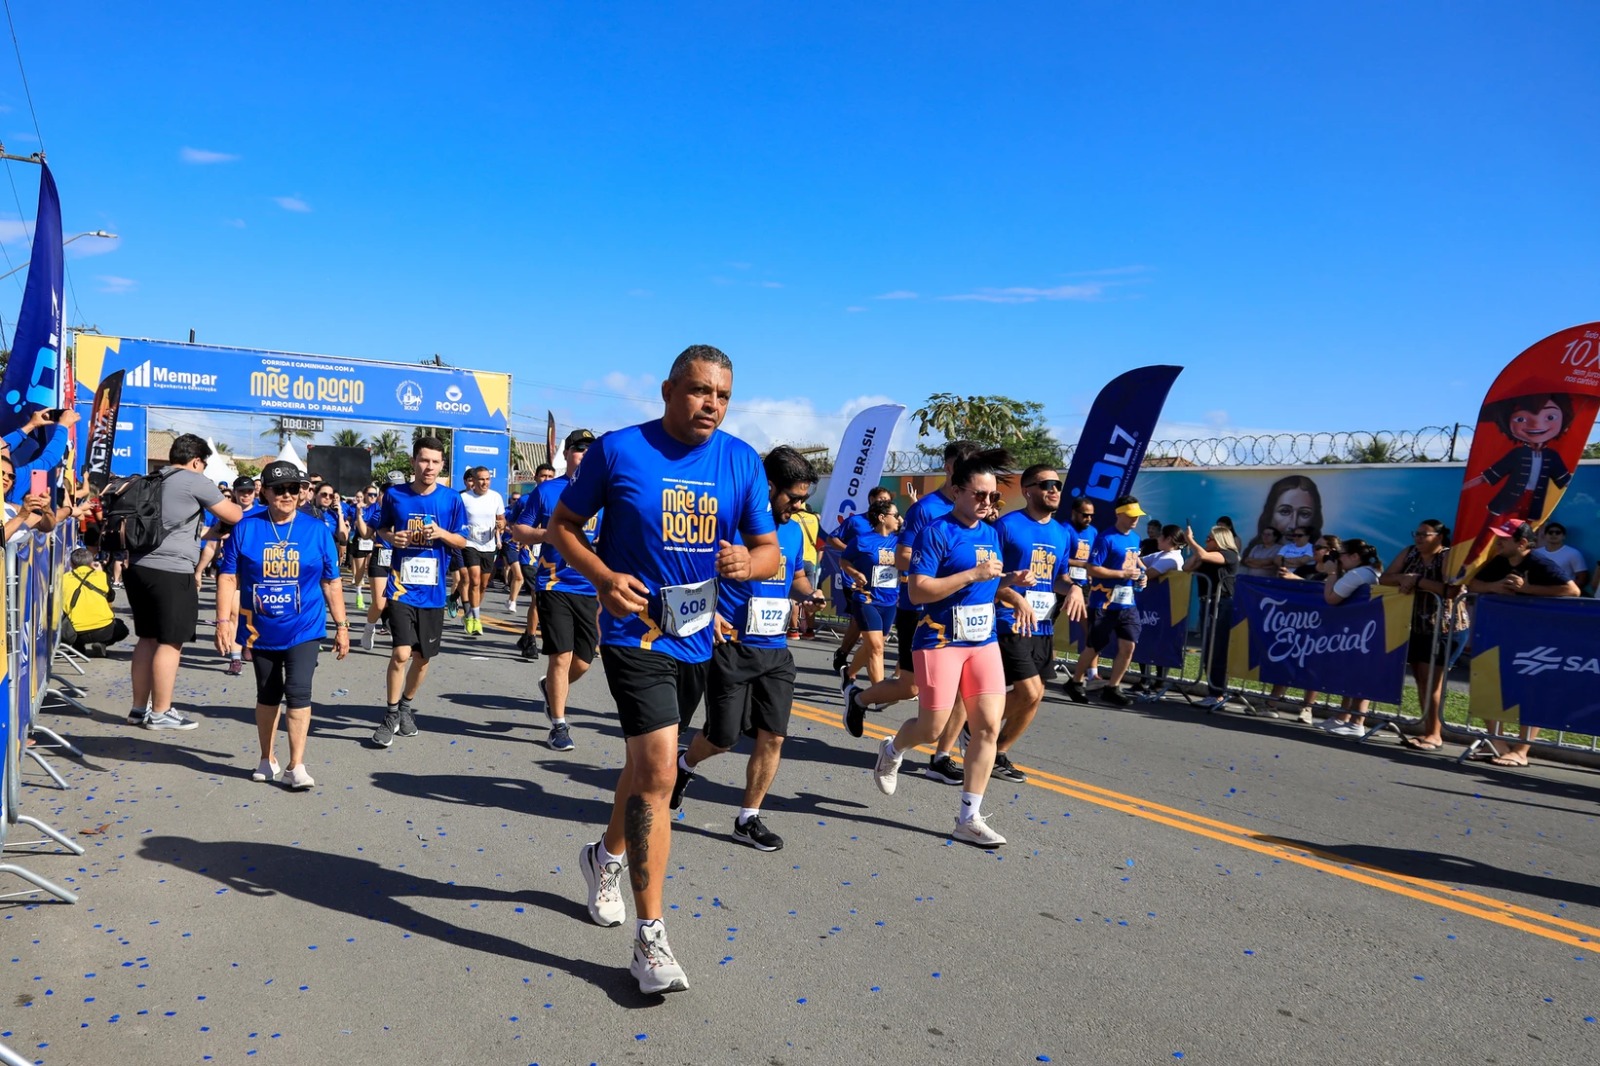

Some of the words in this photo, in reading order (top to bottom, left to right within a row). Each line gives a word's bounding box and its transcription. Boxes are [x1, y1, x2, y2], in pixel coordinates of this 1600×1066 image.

[262, 359, 290, 367] CORRIDA
[296, 362, 334, 371] CAMINHADA
[153, 366, 217, 387] Mempar
[261, 400, 306, 410] PADROEIRA
[322, 404, 354, 413] PARANÁ
[435, 401, 471, 413] ROCIO
[853, 426, 877, 476] BRASIL
[847, 477, 860, 497] CD
[410, 566, 430, 574] 1202
[262, 594, 291, 603] 2065
[1032, 600, 1050, 609] 1324
[680, 598, 706, 615] 608
[761, 609, 783, 620] 1272
[966, 615, 988, 626] 1037
[1268, 619, 1377, 668] Especial
